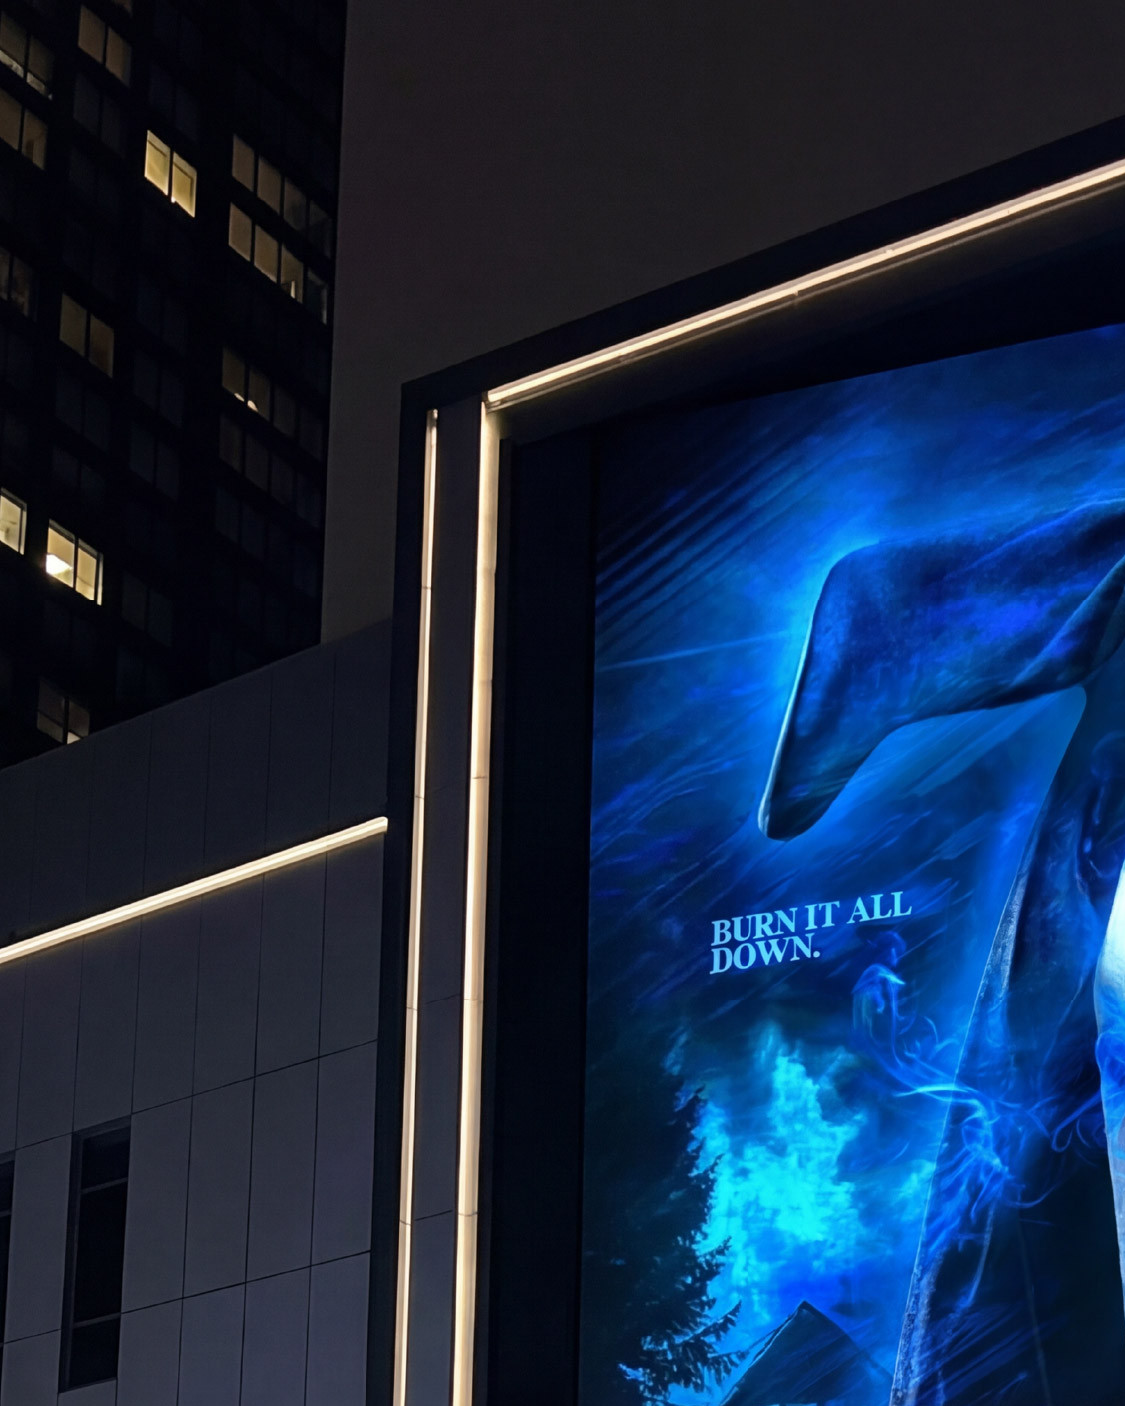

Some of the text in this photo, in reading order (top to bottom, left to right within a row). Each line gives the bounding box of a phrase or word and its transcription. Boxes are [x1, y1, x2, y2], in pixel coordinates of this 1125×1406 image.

[711, 891, 912, 946] BURN IT ALL
[709, 933, 820, 975] DOWN.
